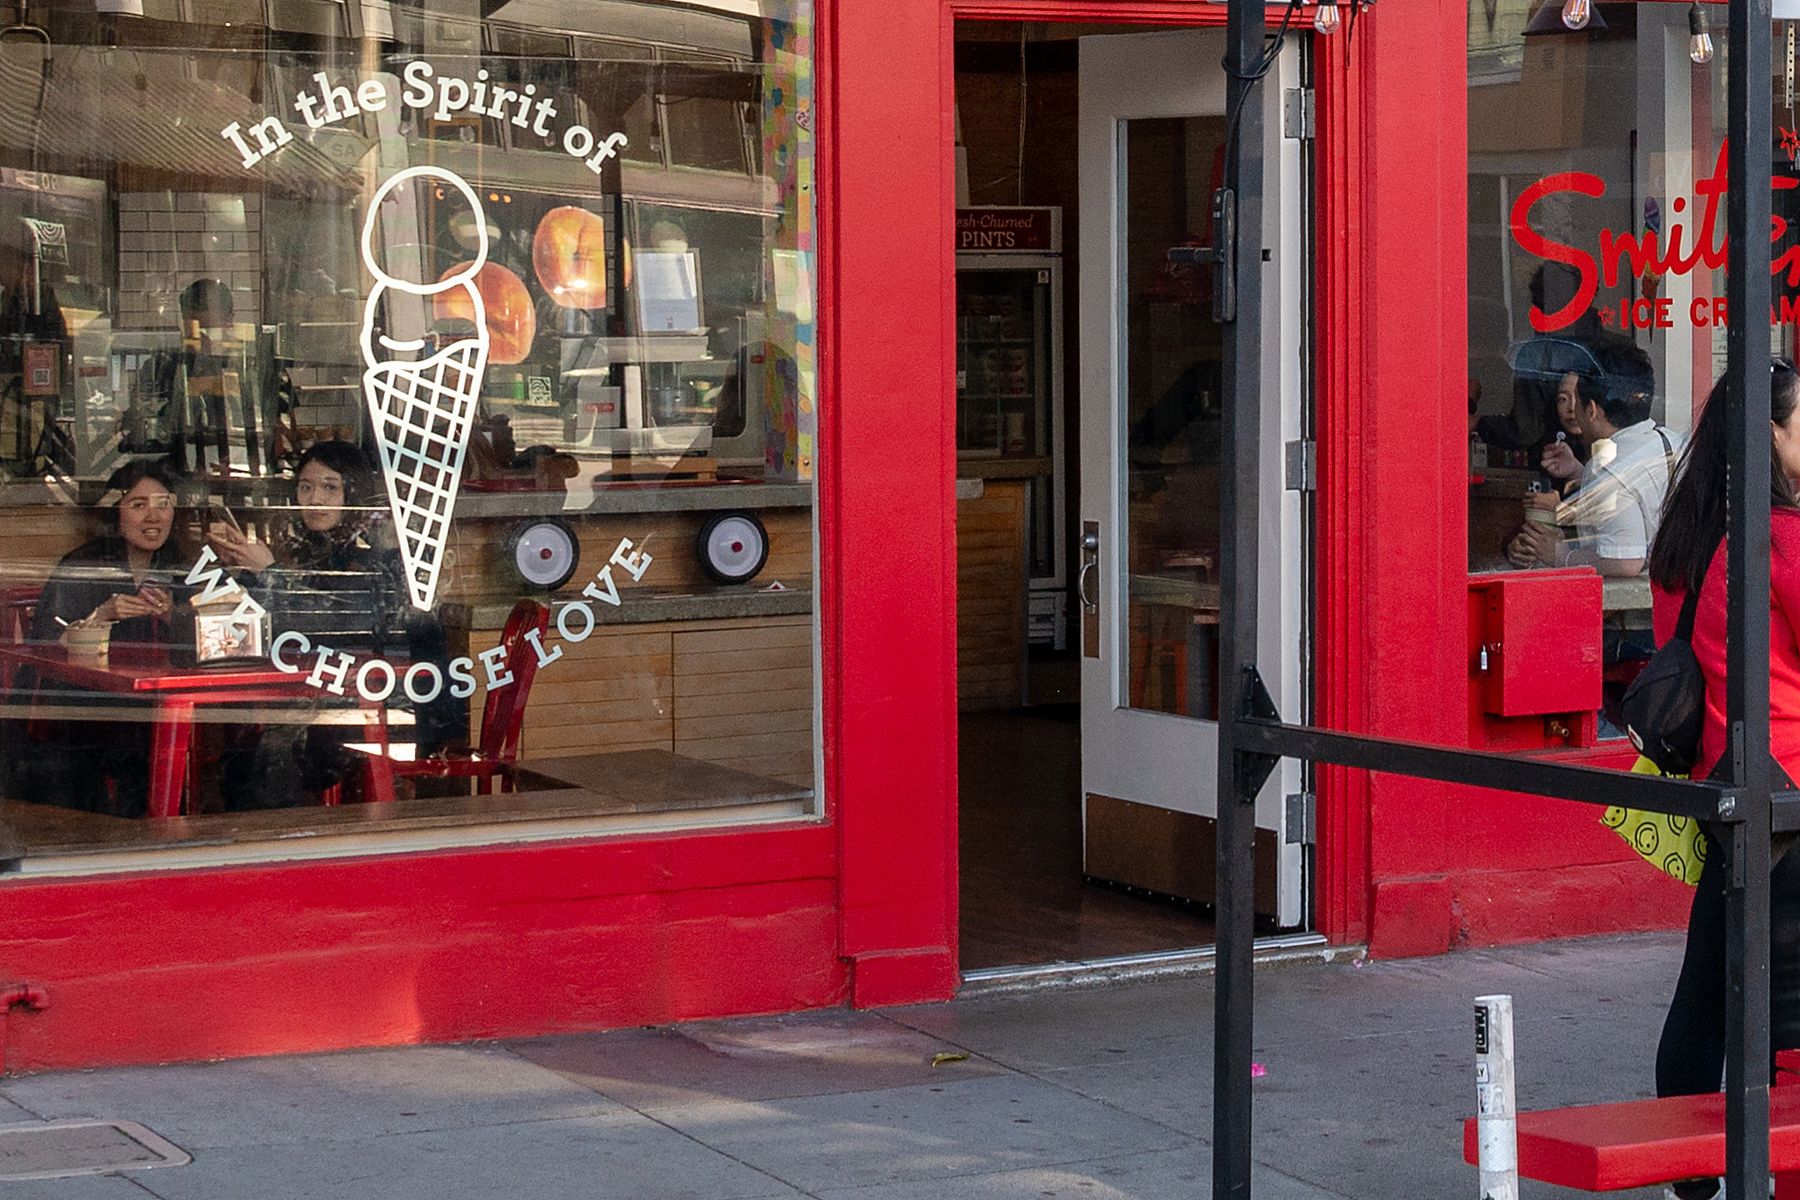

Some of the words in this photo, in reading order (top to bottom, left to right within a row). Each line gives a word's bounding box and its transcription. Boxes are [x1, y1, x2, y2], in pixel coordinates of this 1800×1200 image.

[221, 114, 293, 169] In
[295, 71, 386, 130] the
[402, 61, 557, 137] Spirit
[563, 124, 628, 175] of
[961, 231, 1016, 248] PINTS
[1620, 298, 1674, 329] ICE
[184, 544, 266, 642] WE
[270, 630, 514, 703] CHOOSE
[523, 537, 653, 668] LOVE
